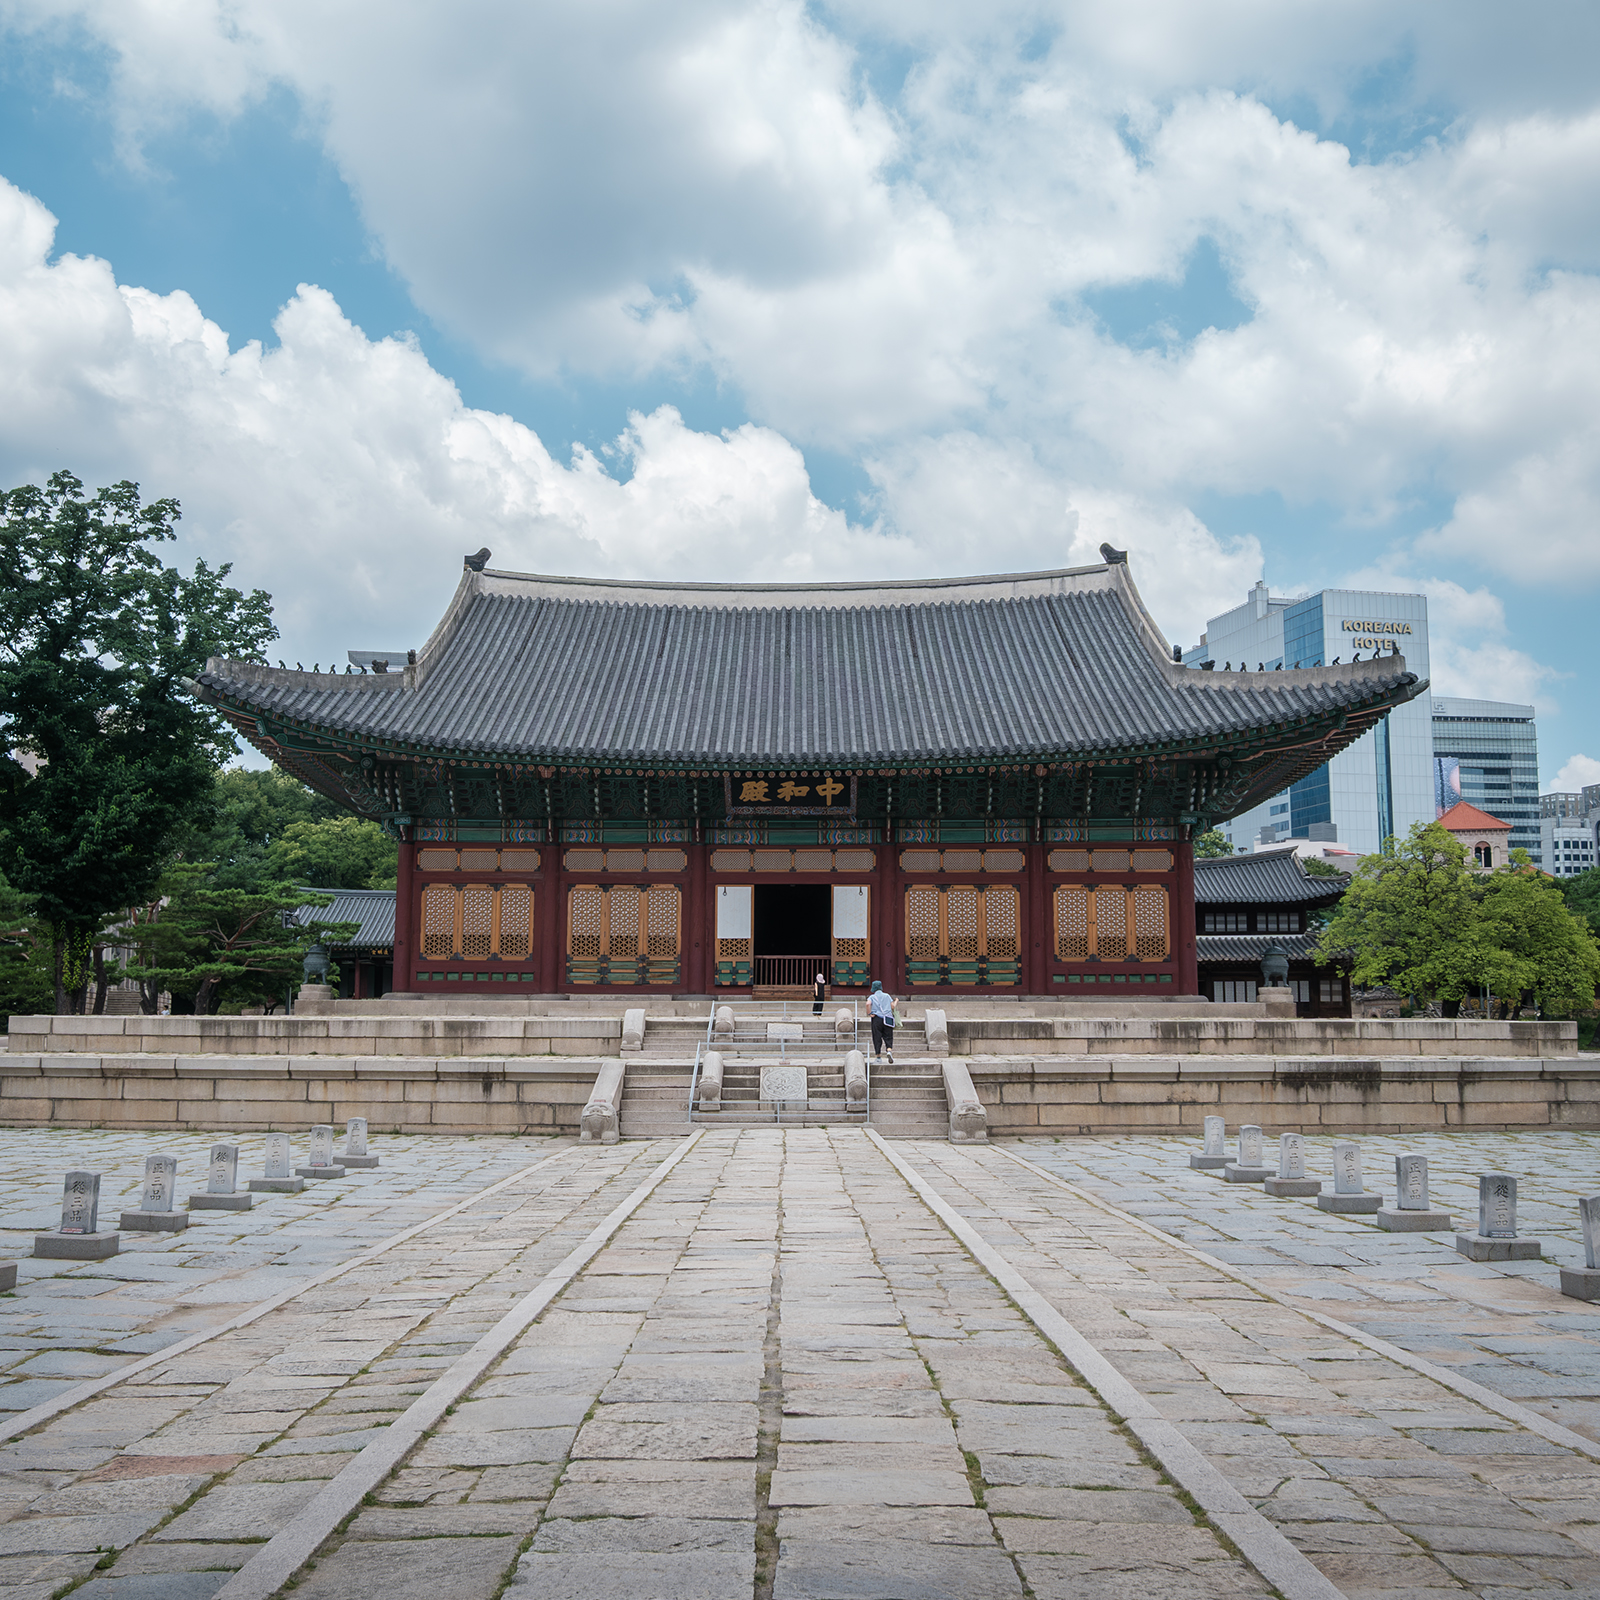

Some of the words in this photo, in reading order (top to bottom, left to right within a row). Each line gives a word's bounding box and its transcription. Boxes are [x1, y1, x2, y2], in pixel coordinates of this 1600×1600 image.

[1342, 620, 1413, 634] KOREANA
[739, 777, 844, 806] 中和殿
[215, 1151, 227, 1185] 從二品
[271, 1138, 281, 1170] 正二品
[1288, 1139, 1299, 1171] 正二品
[1343, 1151, 1356, 1185] 從二品
[150, 1162, 164, 1201] 正三品
[1409, 1162, 1422, 1201] 正三品
[69, 1180, 85, 1222] 從三品
[1493, 1184, 1509, 1227] 從三品
